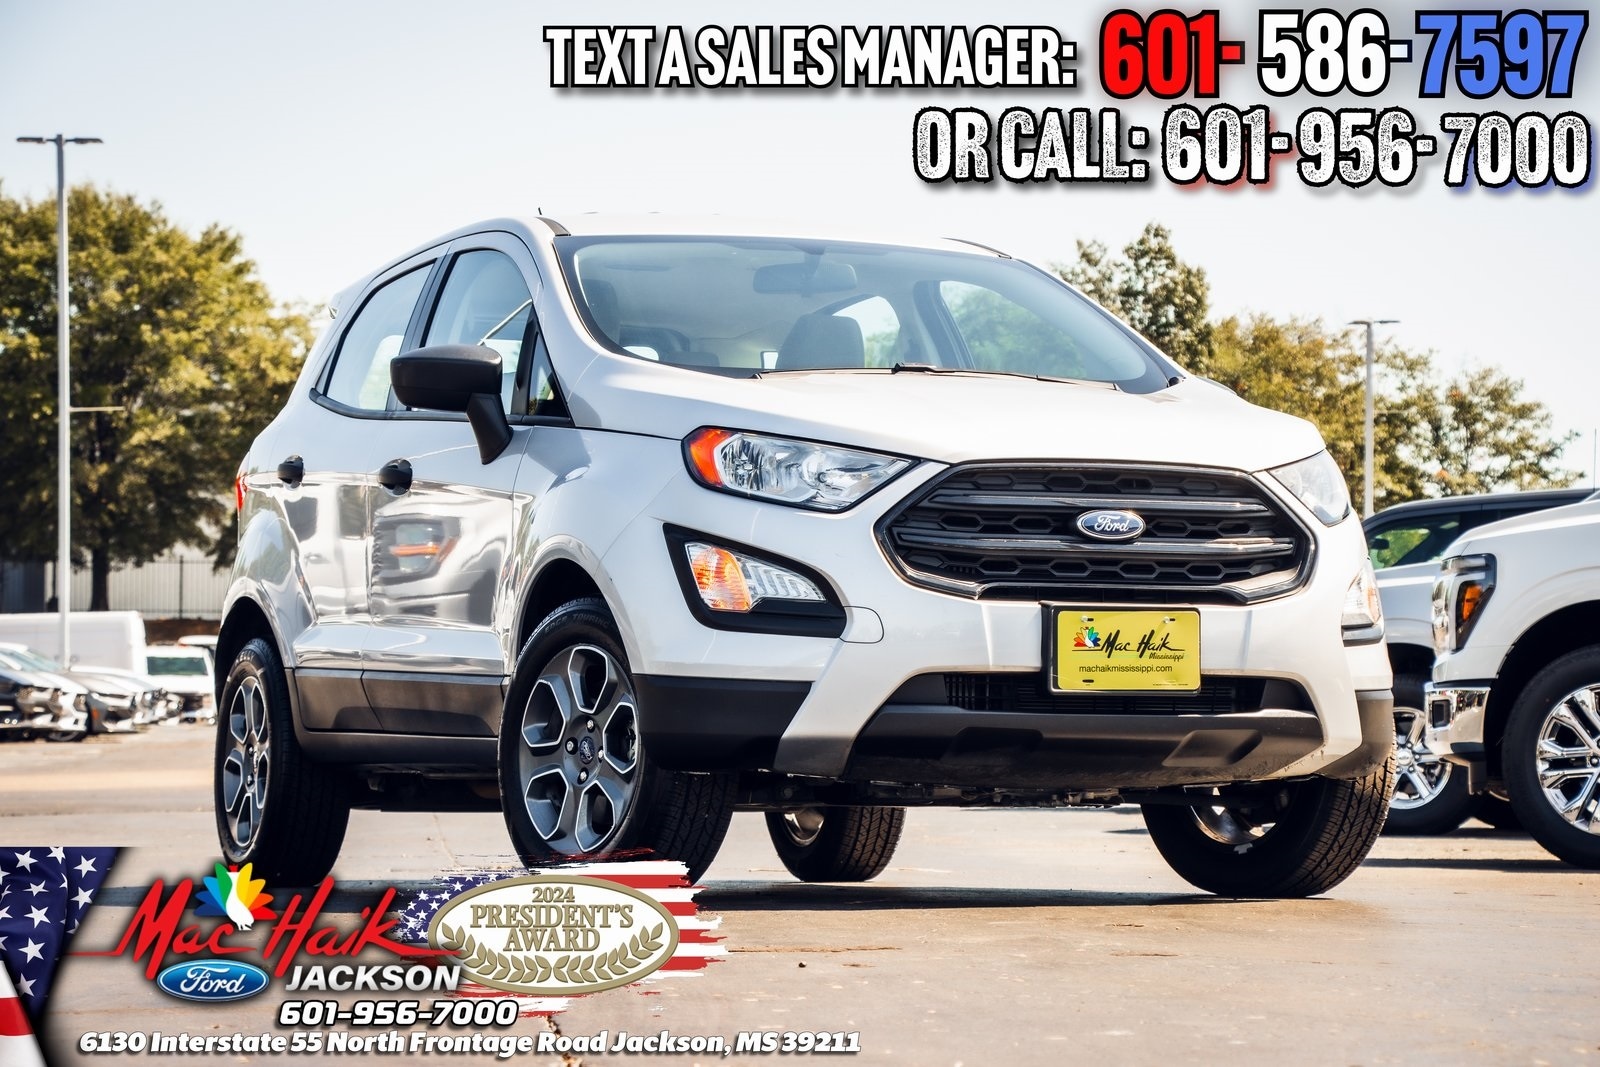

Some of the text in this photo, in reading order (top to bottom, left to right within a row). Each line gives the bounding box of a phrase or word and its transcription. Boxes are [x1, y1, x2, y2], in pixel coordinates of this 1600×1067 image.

[1094, 514, 1130, 532] Ford
[1100, 629, 1175, 659] Mac Haik
[1149, 652, 1184, 662] Mississippi
[1079, 664, 1173, 674] machaikmississippi.com
